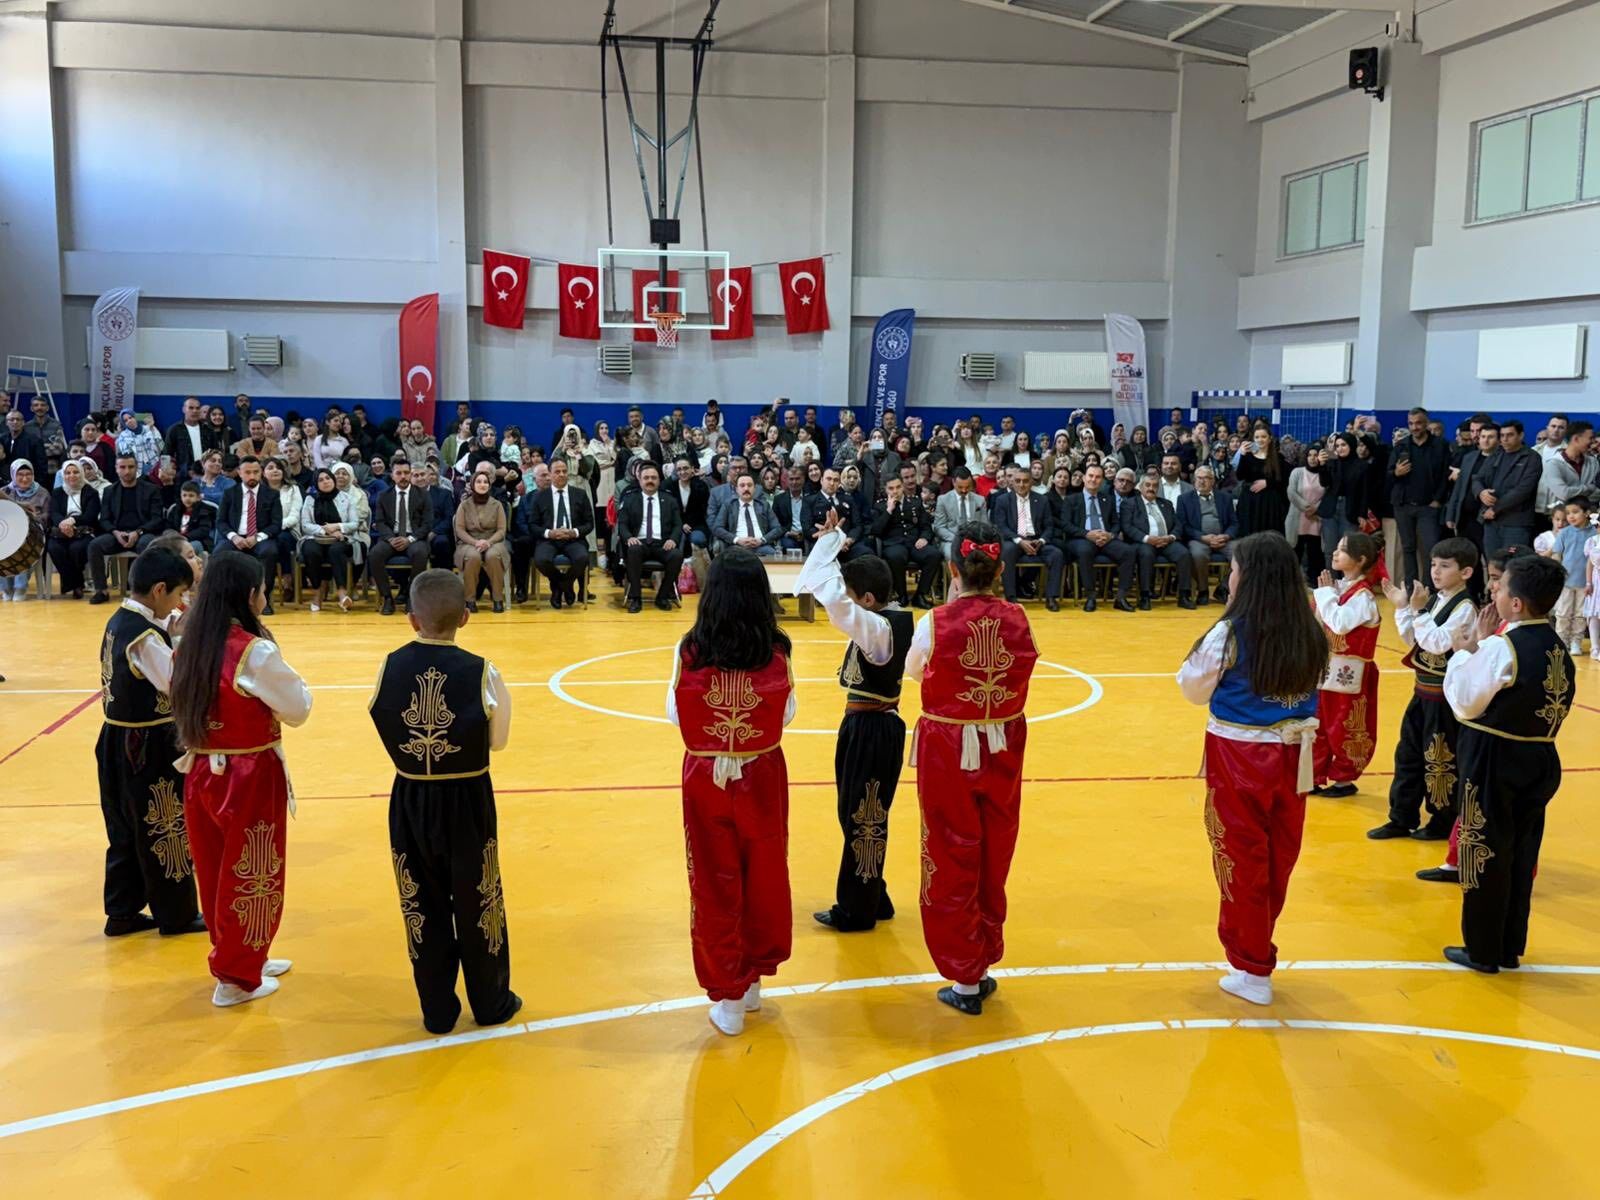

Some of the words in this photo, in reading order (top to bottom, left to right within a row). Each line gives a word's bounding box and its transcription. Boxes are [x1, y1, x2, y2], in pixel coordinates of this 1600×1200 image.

[103, 345, 112, 369] SPOR
[103, 370, 111, 382] VE
[878, 363, 888, 386] SPOR
[101, 383, 111, 413] ENÇLİK
[113, 374, 125, 410] ÜRLÜĞÜ
[877, 386, 885, 398] VE
[874, 398, 884, 427] ENÇLİK
